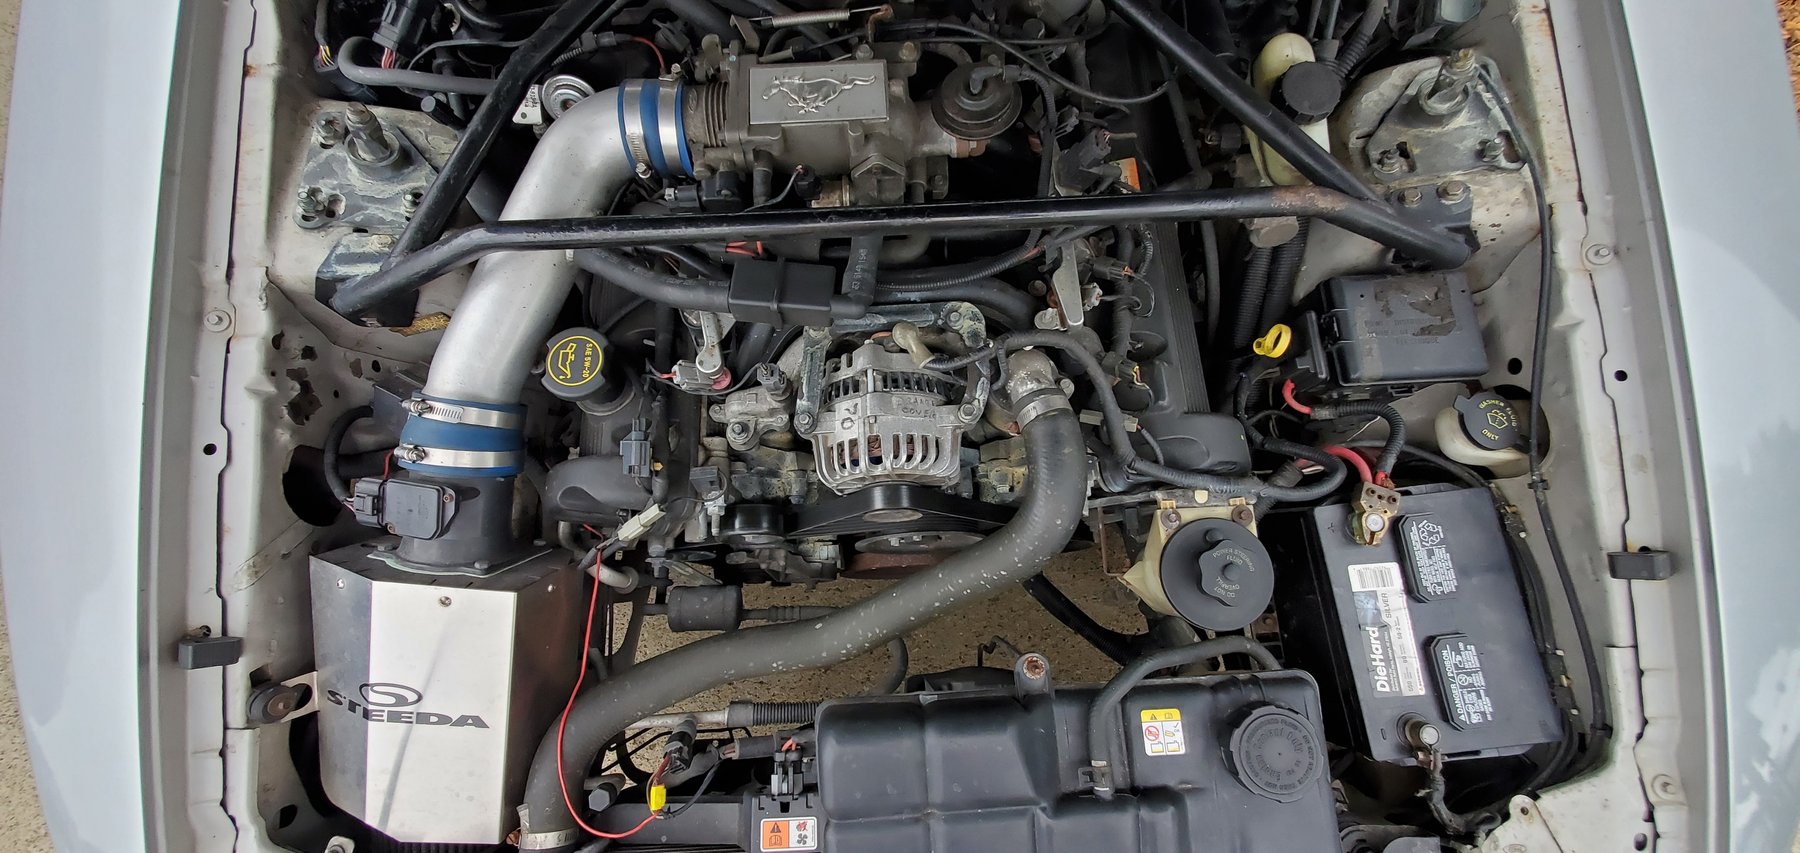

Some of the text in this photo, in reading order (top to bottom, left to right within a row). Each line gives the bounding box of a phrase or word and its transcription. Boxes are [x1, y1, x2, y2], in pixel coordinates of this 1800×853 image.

[582, 343, 593, 378] SAE 5W-20
[1482, 428, 1499, 441] ONLY
[1212, 547, 1255, 572] POWER STEERING
[1226, 554, 1243, 566] FLUID
[1214, 586, 1226, 596] NOT
[1216, 575, 1240, 590] OVERFILL
[1381, 592, 1392, 619] SILVER
[1365, 625, 1391, 693] DieHard
[1441, 649, 1454, 677] POISON
[327, 689, 490, 729] STEEDA
[1450, 684, 1464, 714] DANGER
